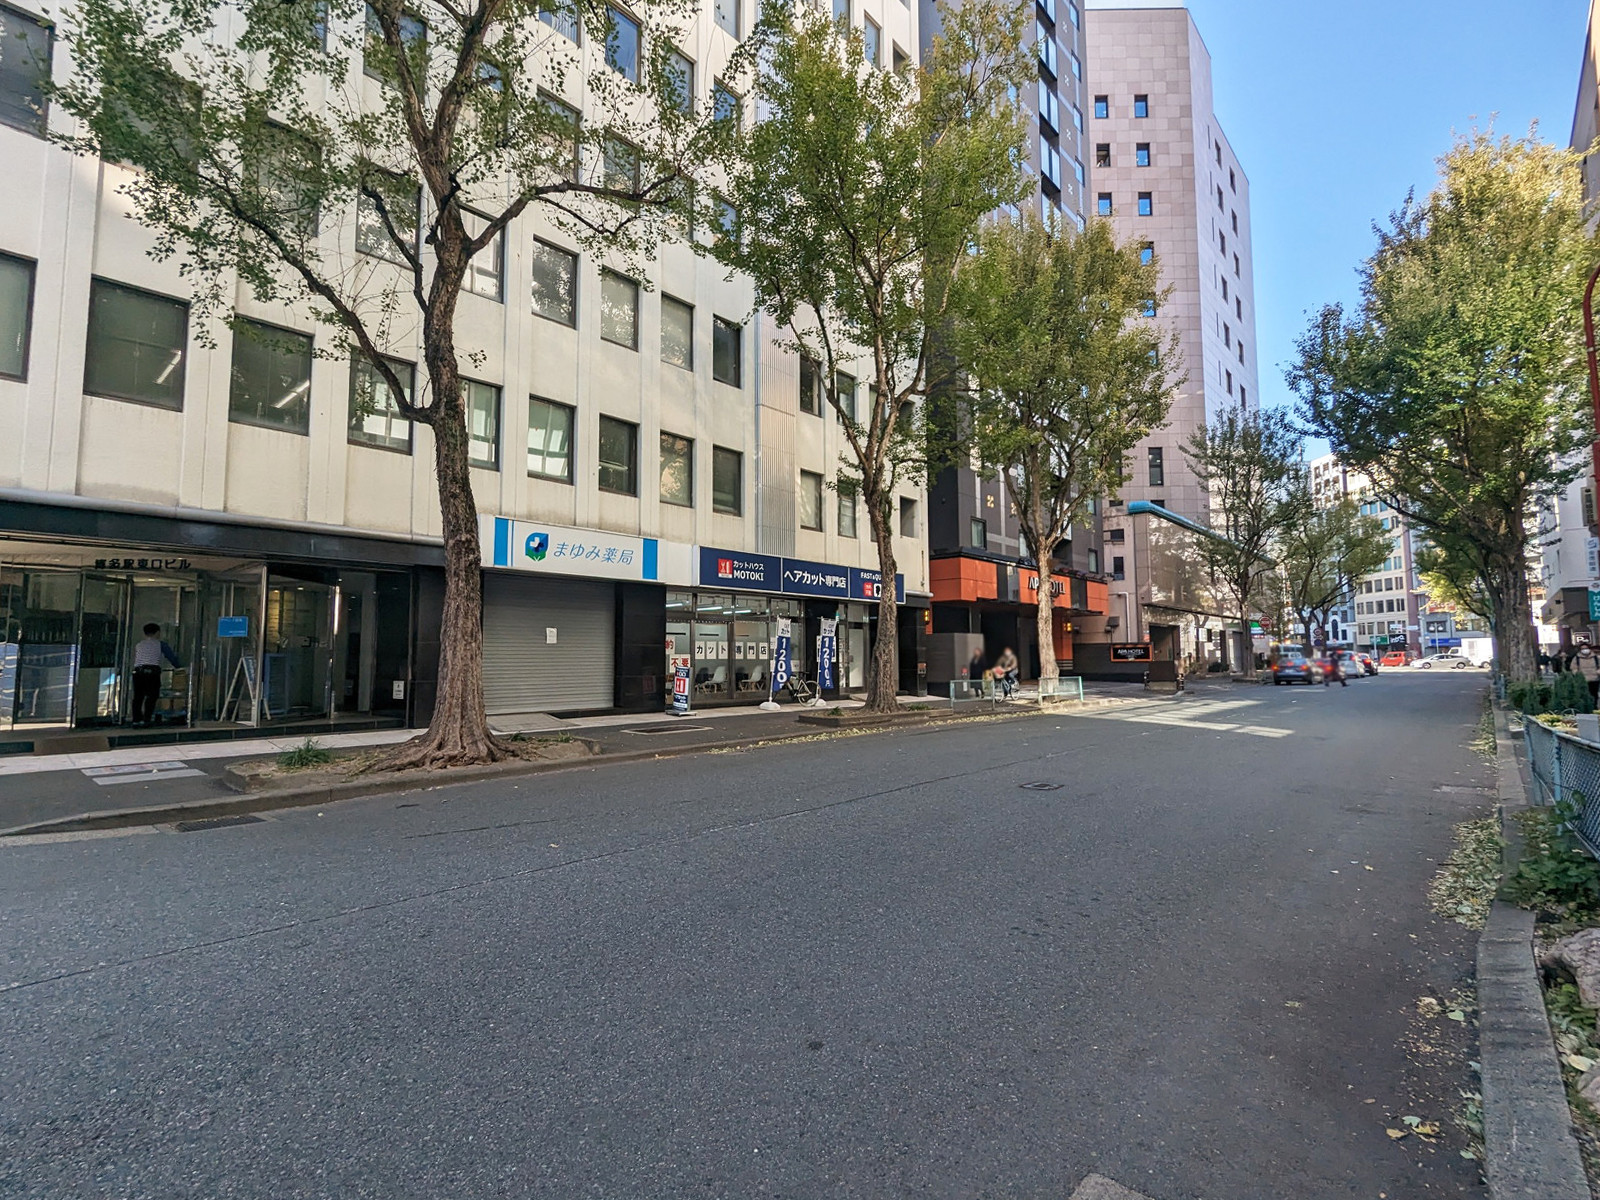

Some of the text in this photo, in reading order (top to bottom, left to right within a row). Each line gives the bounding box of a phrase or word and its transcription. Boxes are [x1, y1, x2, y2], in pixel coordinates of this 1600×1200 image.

[553, 542, 634, 565] まゆみ薬局
[733, 560, 764, 571] カットハウス
[733, 570, 764, 581] MOTOKI
[784, 570, 846, 588] ヘアカット専門店
